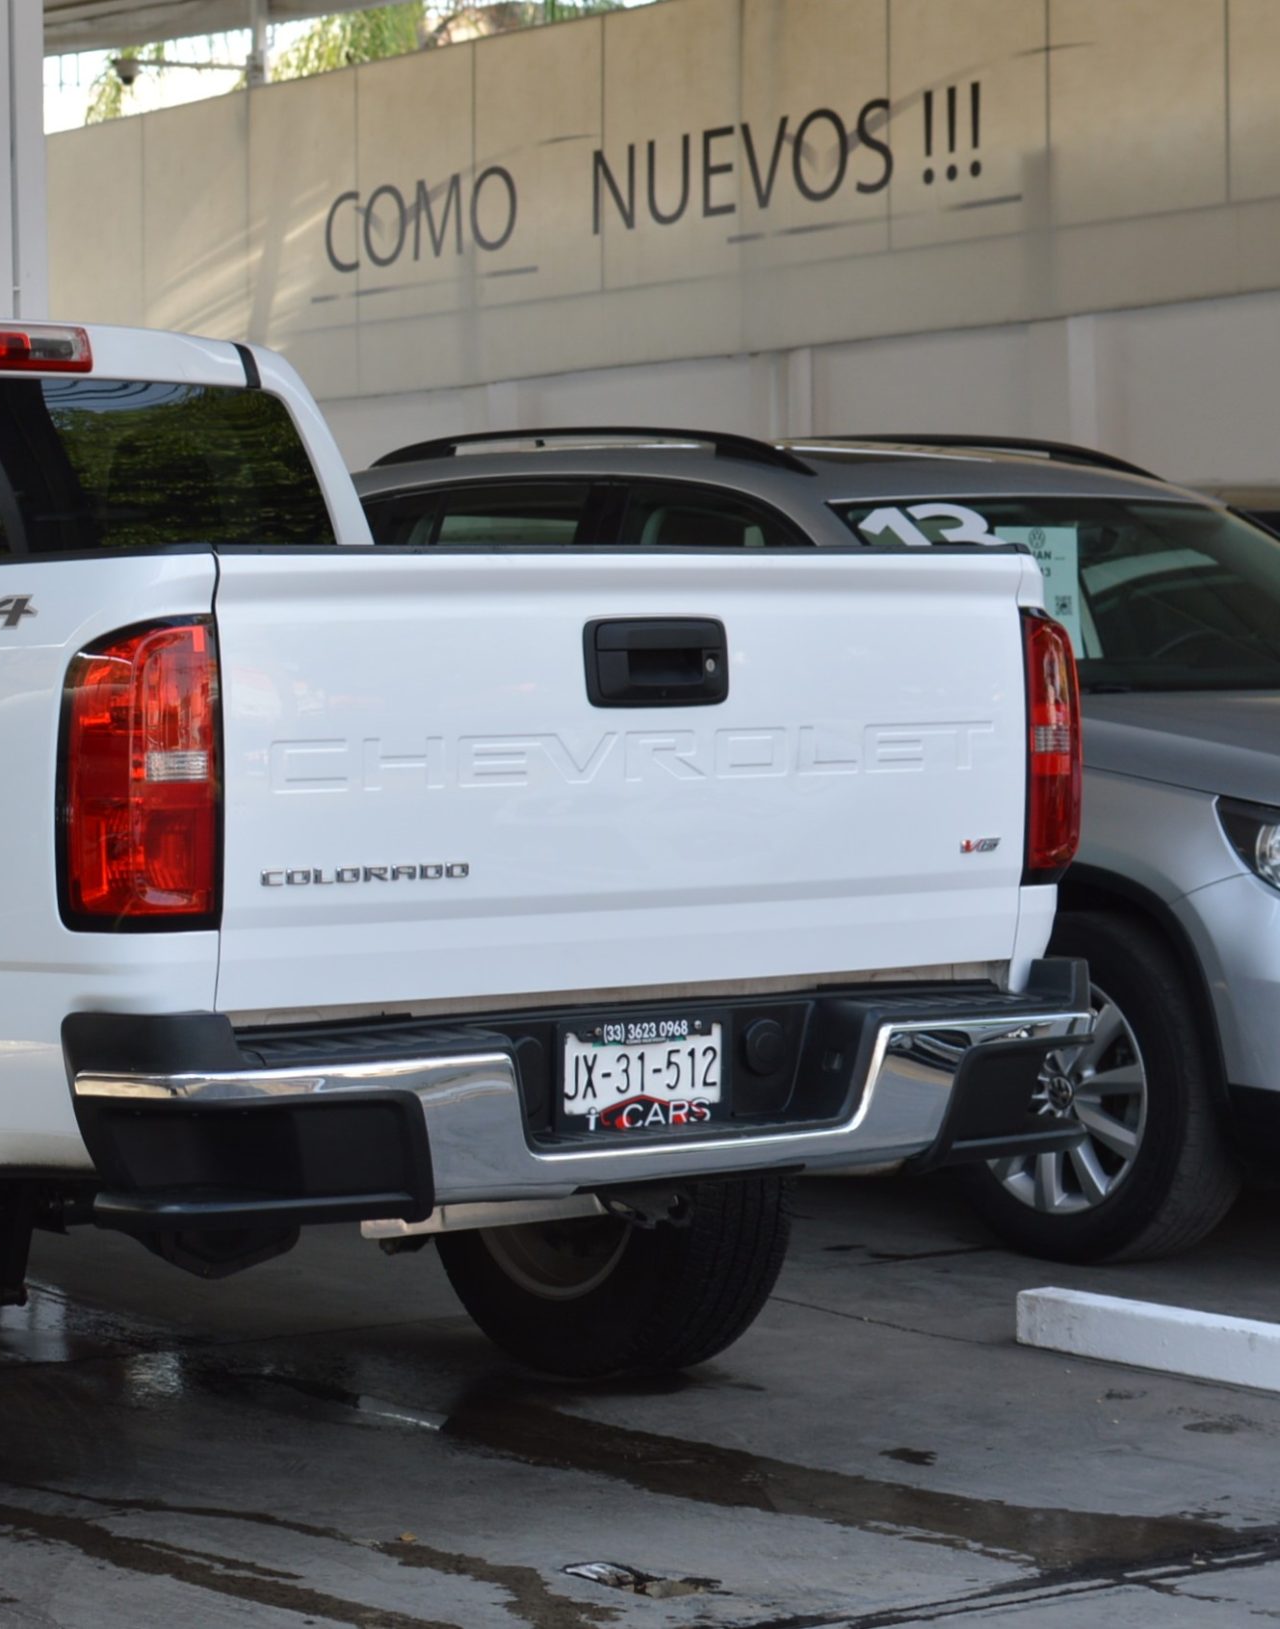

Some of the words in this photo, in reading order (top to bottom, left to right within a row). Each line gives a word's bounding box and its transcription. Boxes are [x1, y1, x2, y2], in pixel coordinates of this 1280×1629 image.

[325, 166, 518, 273] COMO
[270, 720, 995, 795] CHEVROLET
[260, 862, 470, 887] COLORADO
[603, 1022, 626, 1044] (33)
[627, 1023, 657, 1040] 3623
[659, 1019, 689, 1038] 0968
[563, 1045, 718, 1100] JX-31-512
[622, 1097, 711, 1129] CARS
